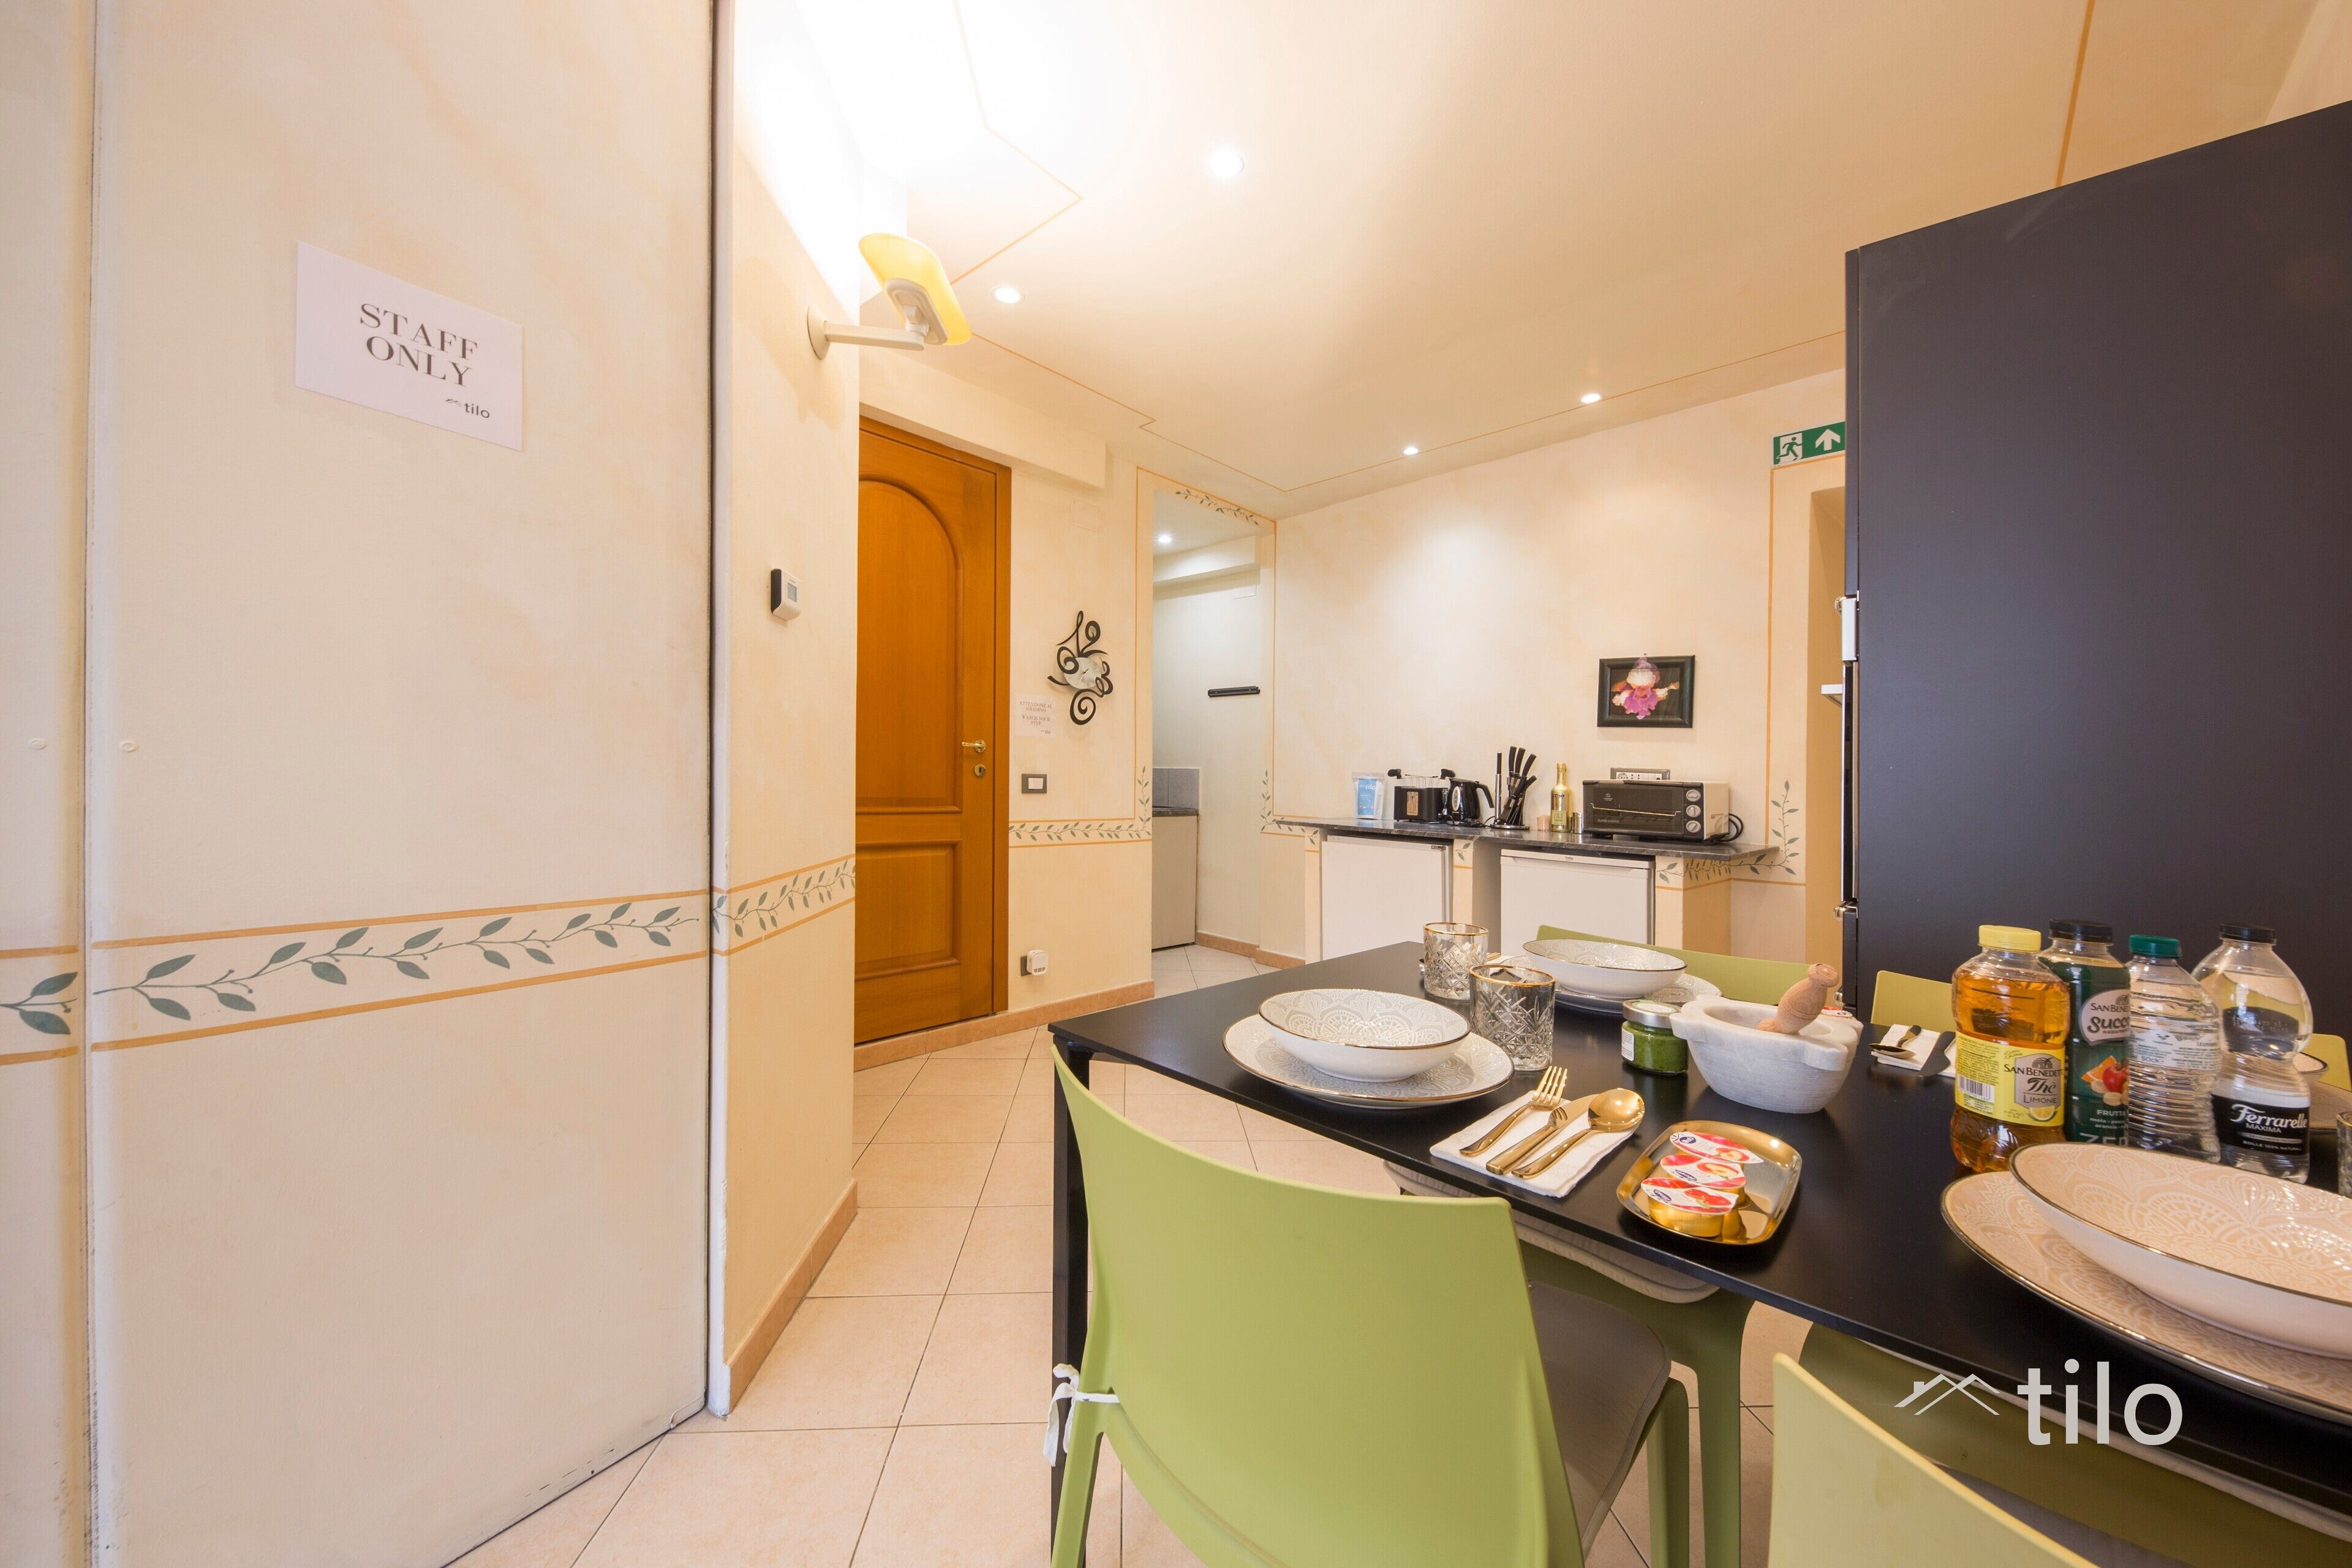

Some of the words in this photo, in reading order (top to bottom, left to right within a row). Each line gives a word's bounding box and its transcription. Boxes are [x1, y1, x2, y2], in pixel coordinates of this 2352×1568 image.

[360, 303, 478, 360] STAFF
[366, 336, 472, 387] ONLY
[464, 402, 490, 418] tilo
[2090, 1003, 2110, 1012] SAN
[2087, 1016, 2130, 1033] Succ
[2004, 1064, 2024, 1075] SAN
[2027, 1077, 2057, 1093] Thè
[2024, 1095, 2057, 1103] LIMONE
[2230, 1104, 2308, 1128] Ferrarelle
[2246, 1123, 2282, 1133] MAXIMA
